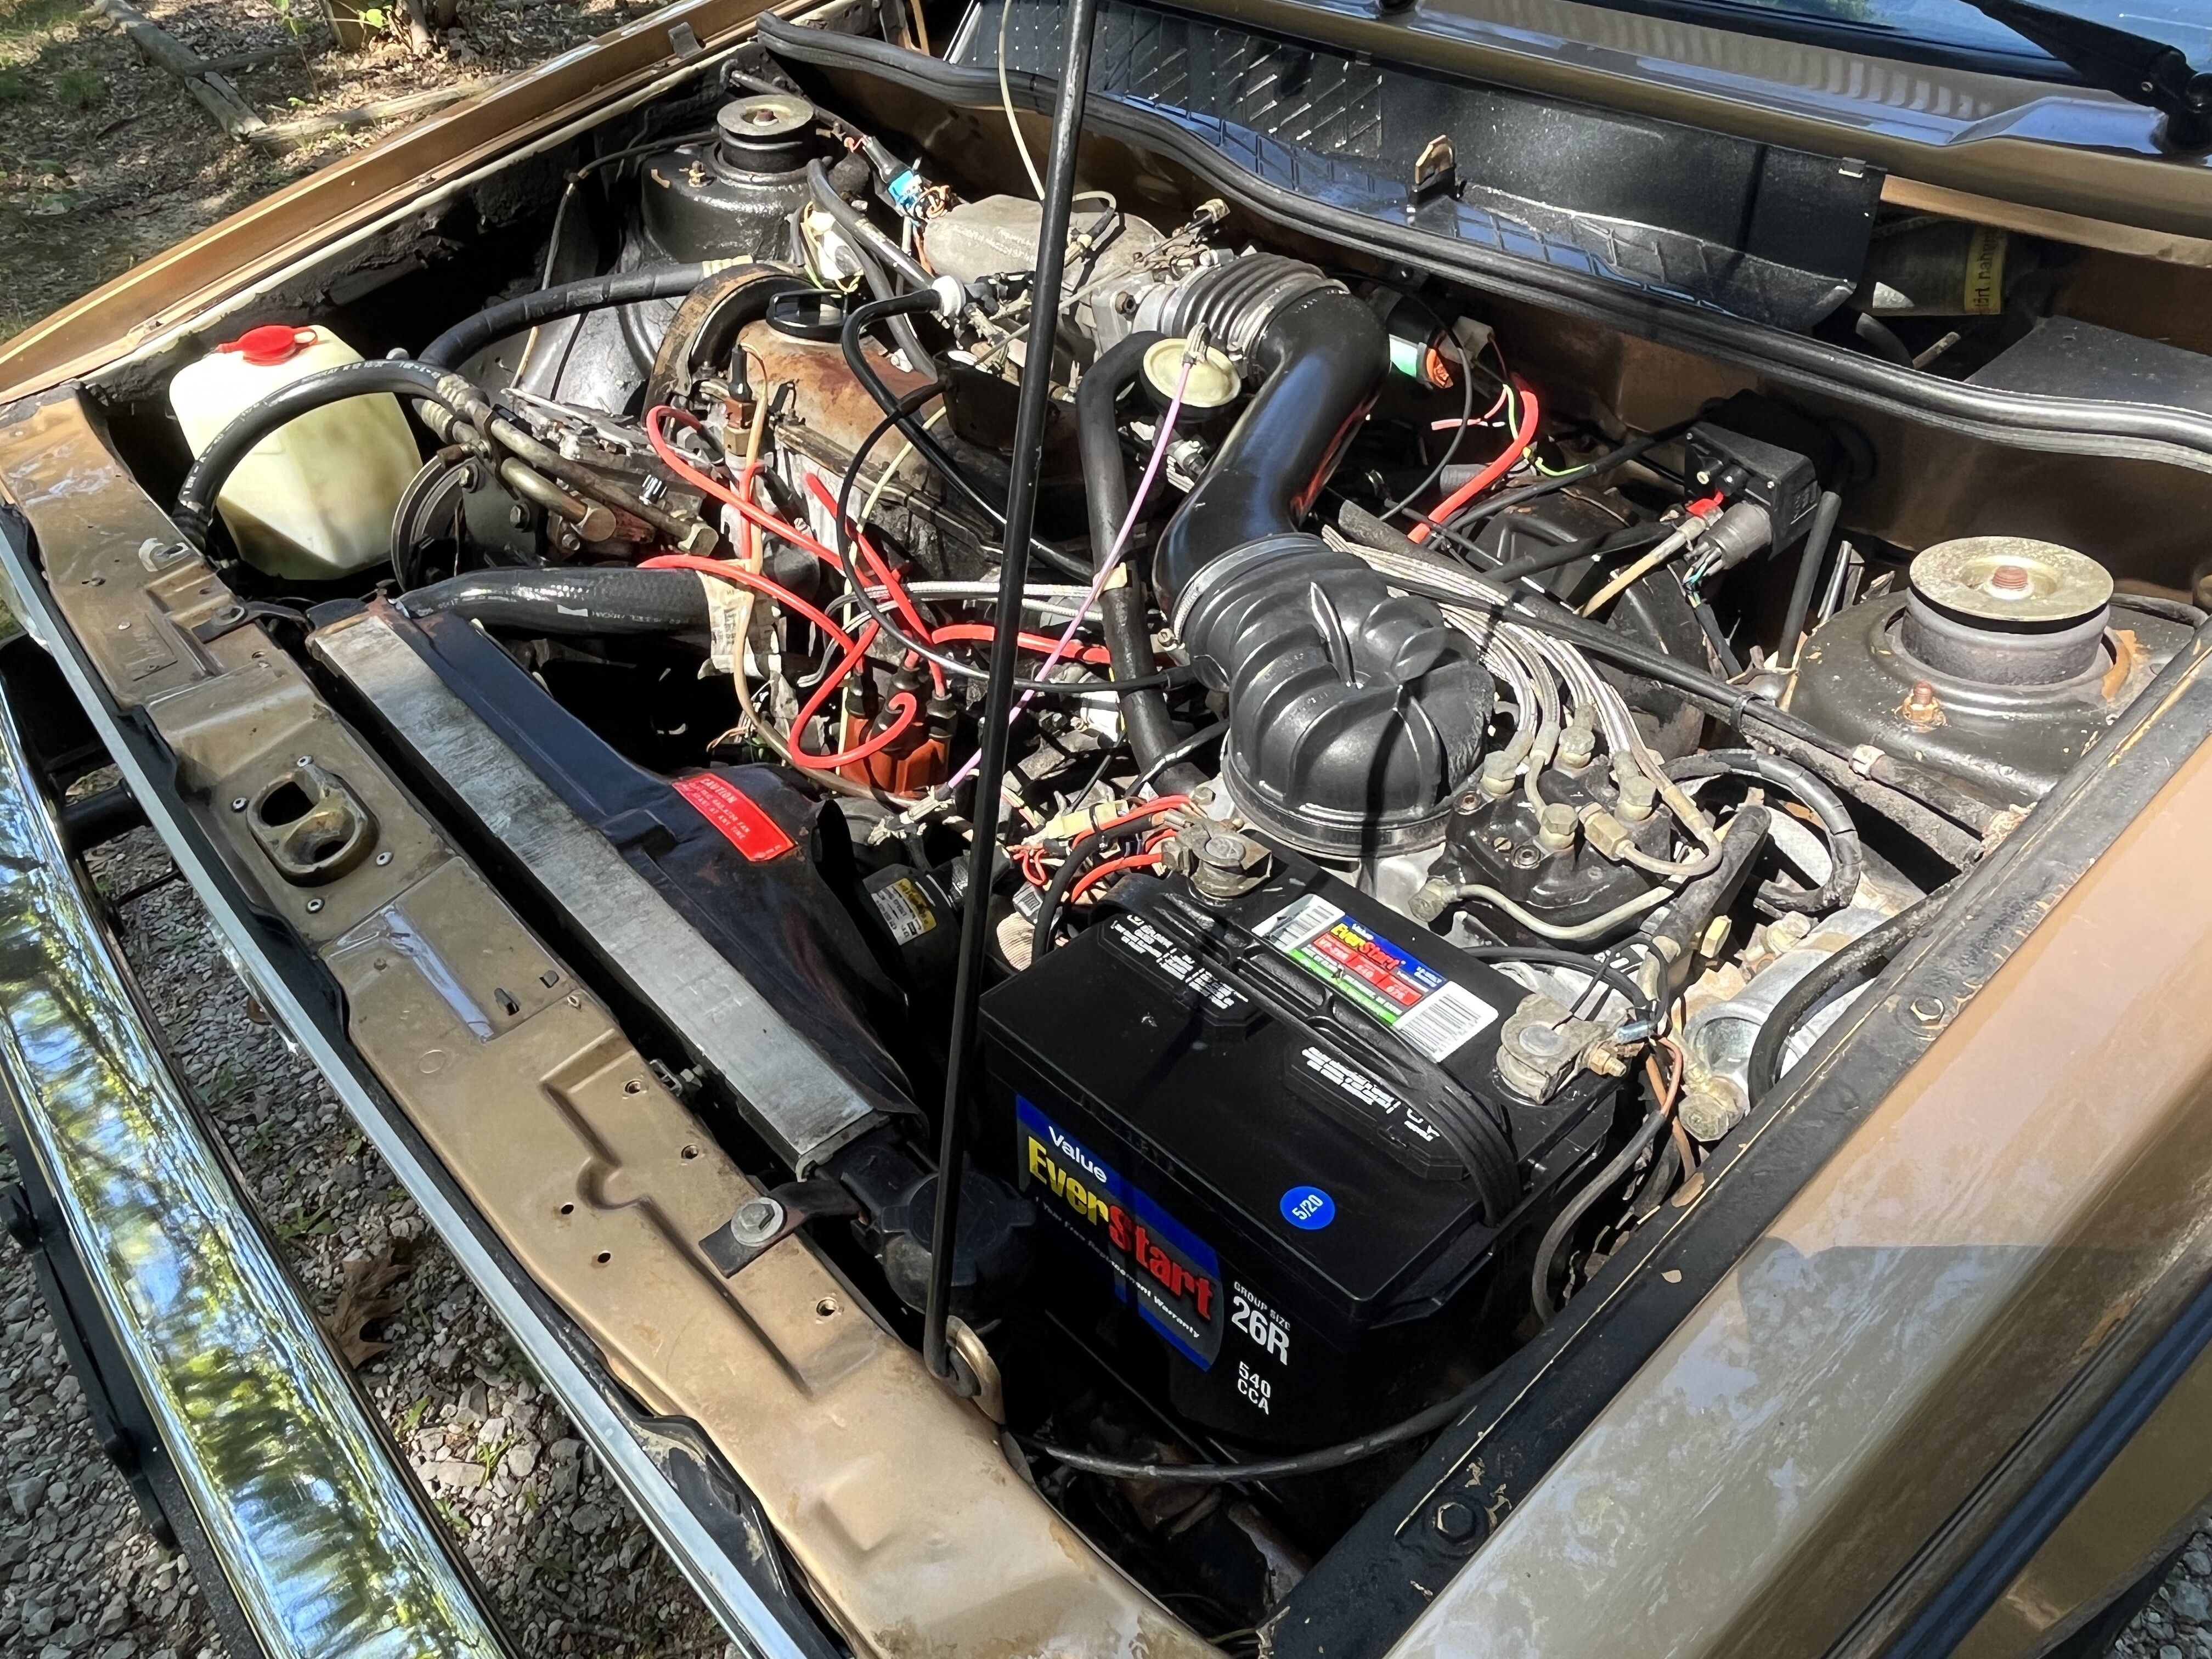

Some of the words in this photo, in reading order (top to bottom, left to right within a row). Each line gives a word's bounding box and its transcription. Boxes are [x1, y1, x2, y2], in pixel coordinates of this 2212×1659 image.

[700, 778, 737, 803] CAUTION
[1330, 923, 1401, 970] EverStart
[1048, 1126, 1107, 1183] Value
[1029, 1136, 1214, 1321] EverStart
[1291, 1194, 1323, 1220] 5/20
[1154, 1295, 1200, 1338] Warranty
[1234, 1281, 1268, 1310] GROUP
[1269, 1309, 1291, 1331] SIZE
[1232, 1296, 1289, 1365] 26R
[1237, 1378, 1269, 1415] CCA
[1239, 1361, 1271, 1398] 540
